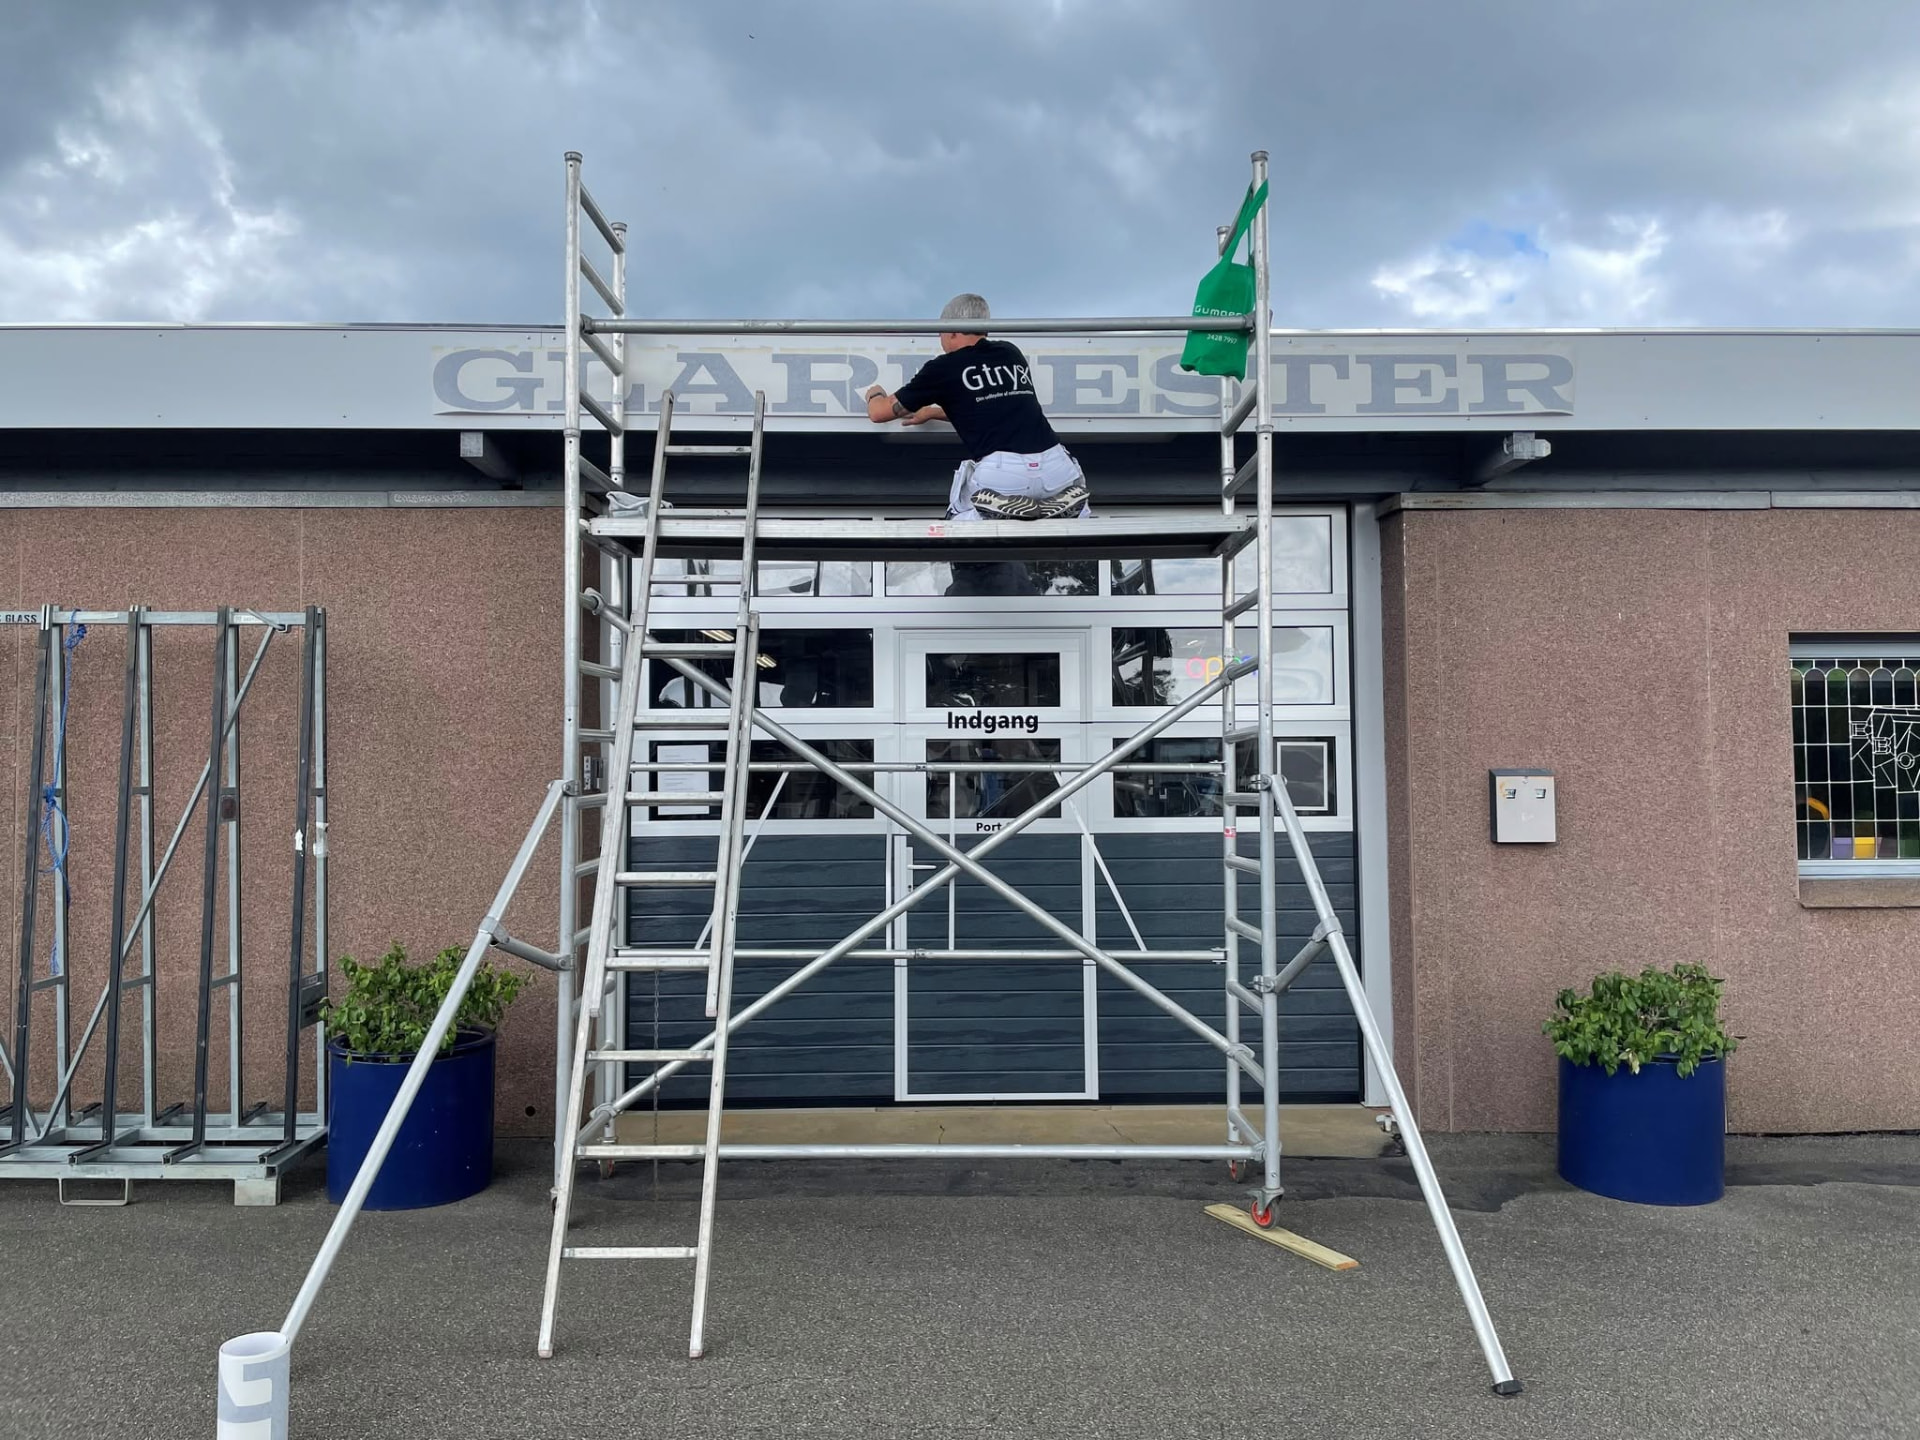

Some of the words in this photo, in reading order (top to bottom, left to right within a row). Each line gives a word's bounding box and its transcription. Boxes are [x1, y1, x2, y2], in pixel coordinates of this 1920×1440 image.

[433, 349, 1574, 413] GLARESTER
[5, 614, 37, 623] GLASS
[947, 710, 1039, 734] Indgang
[976, 822, 1002, 832] Port
